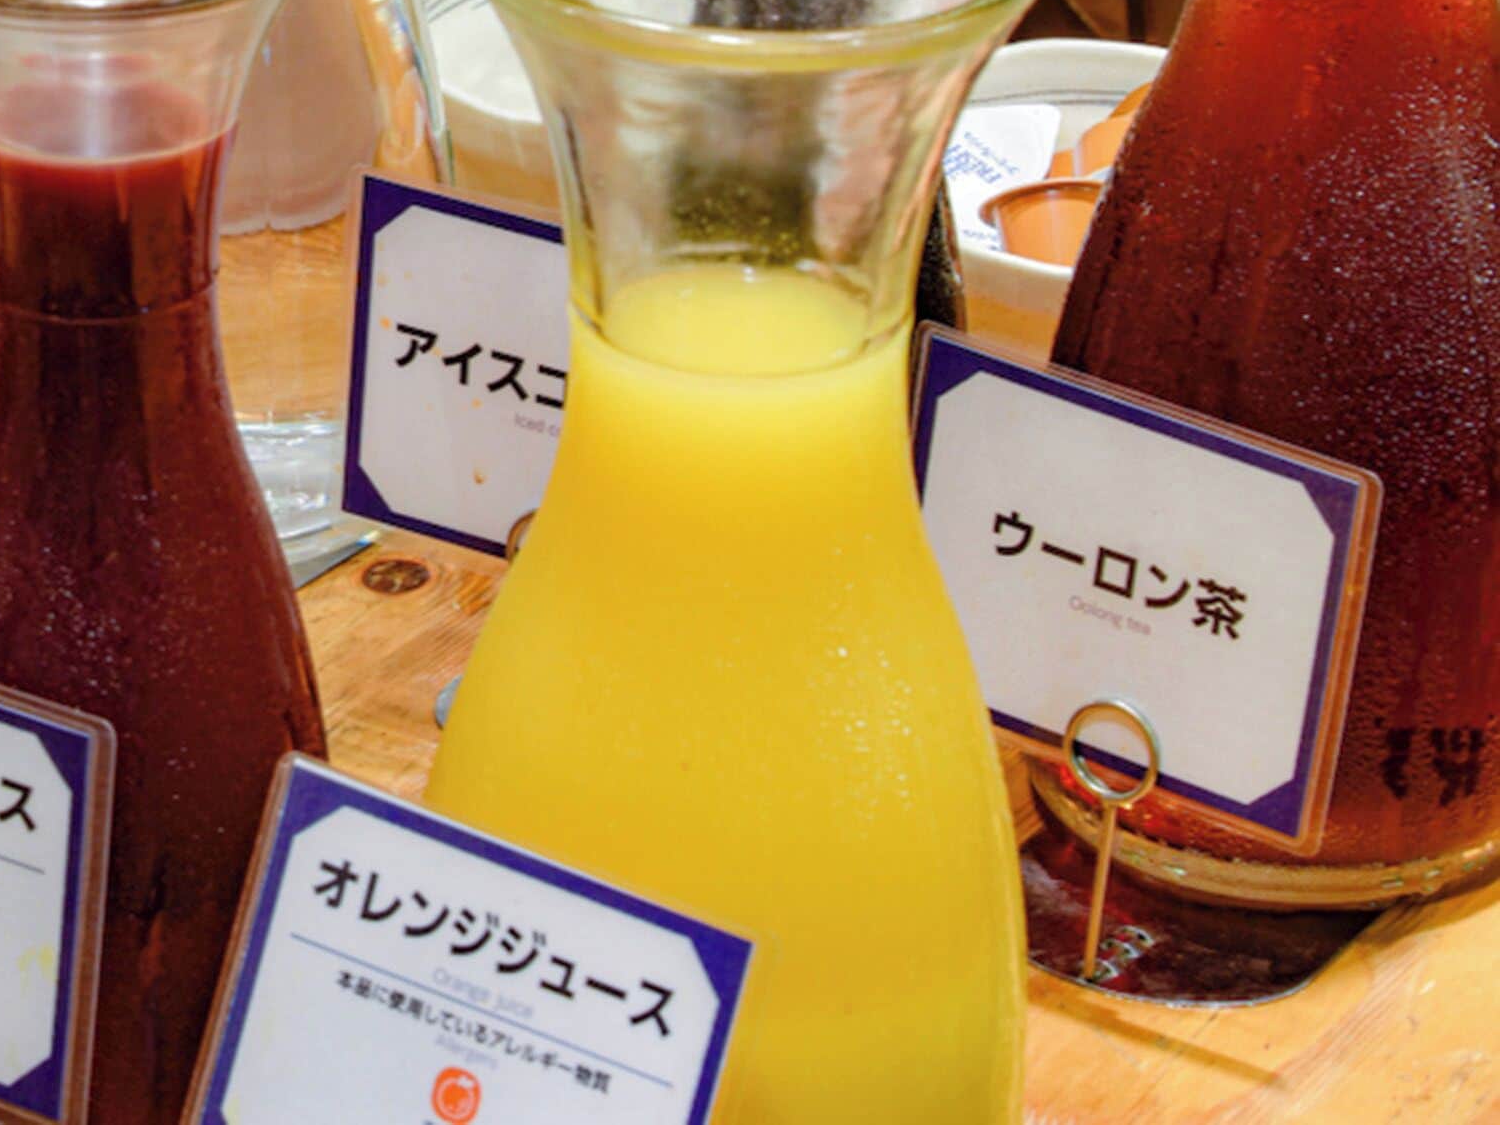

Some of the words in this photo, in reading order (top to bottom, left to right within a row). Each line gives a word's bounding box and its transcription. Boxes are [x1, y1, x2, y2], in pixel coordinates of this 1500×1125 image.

[992, 511, 1247, 641] ウーロン茶
[312, 859, 675, 1038] オレンジジュース
